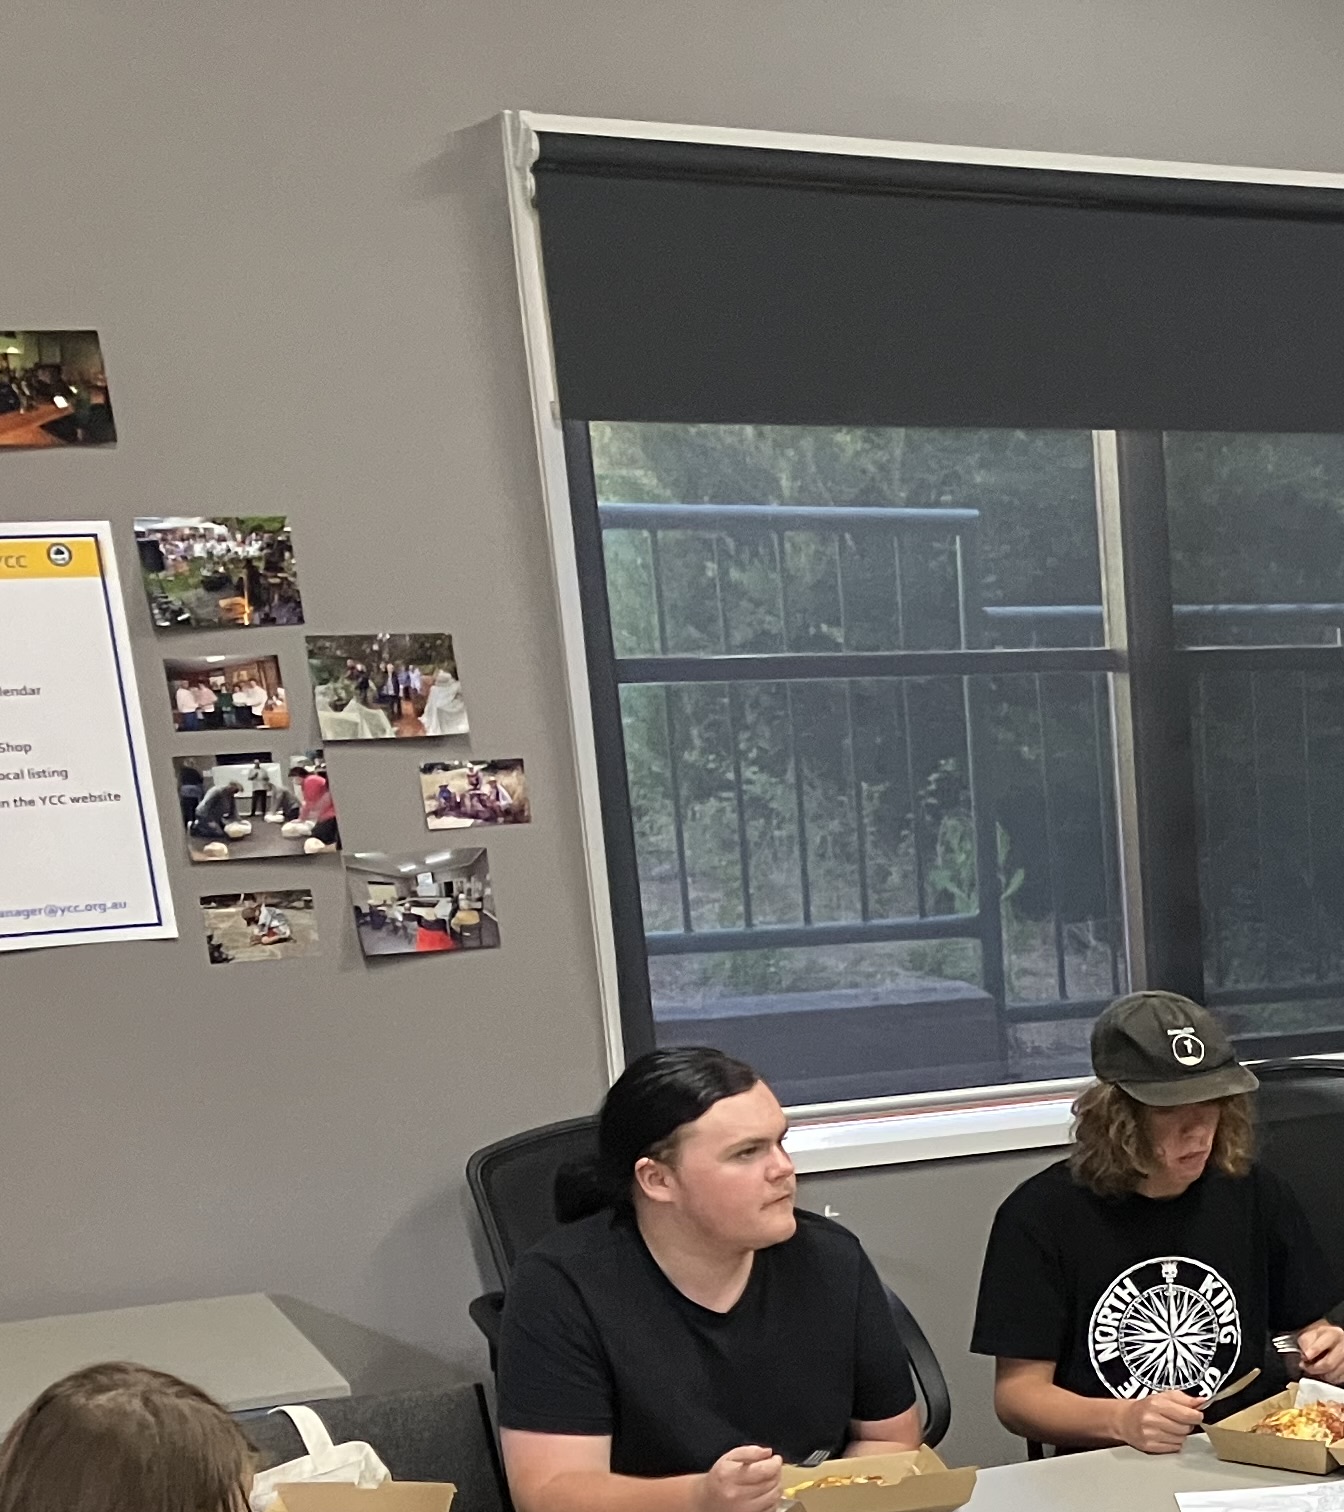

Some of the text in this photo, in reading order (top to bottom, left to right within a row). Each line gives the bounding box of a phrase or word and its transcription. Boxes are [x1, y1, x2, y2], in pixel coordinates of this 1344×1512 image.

[0, 743, 32, 756] Shop
[27, 768, 70, 781] listing
[13, 791, 122, 809] the YCC website
[1198, 1273, 1239, 1345] KING
[1094, 1277, 1142, 1363] NORTH
